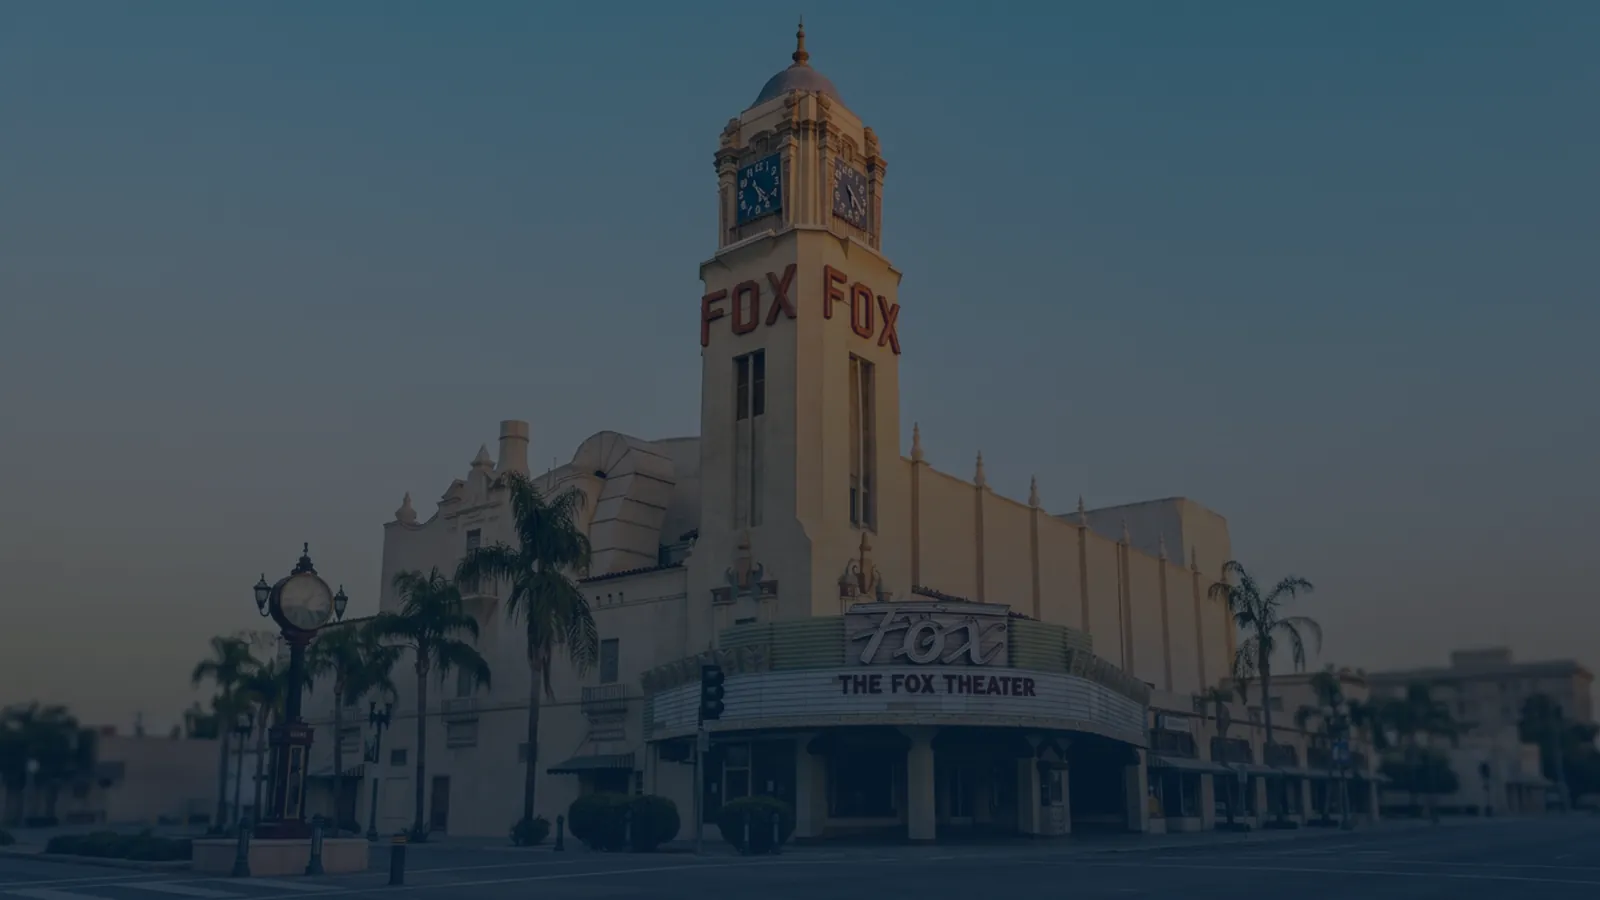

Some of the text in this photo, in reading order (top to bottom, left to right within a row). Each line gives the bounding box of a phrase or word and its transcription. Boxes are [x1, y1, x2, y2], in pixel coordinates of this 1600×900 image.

[701, 263, 797, 347] FOX
[823, 264, 902, 355] FOX
[838, 674, 1036, 697] THE FOX THEATER
